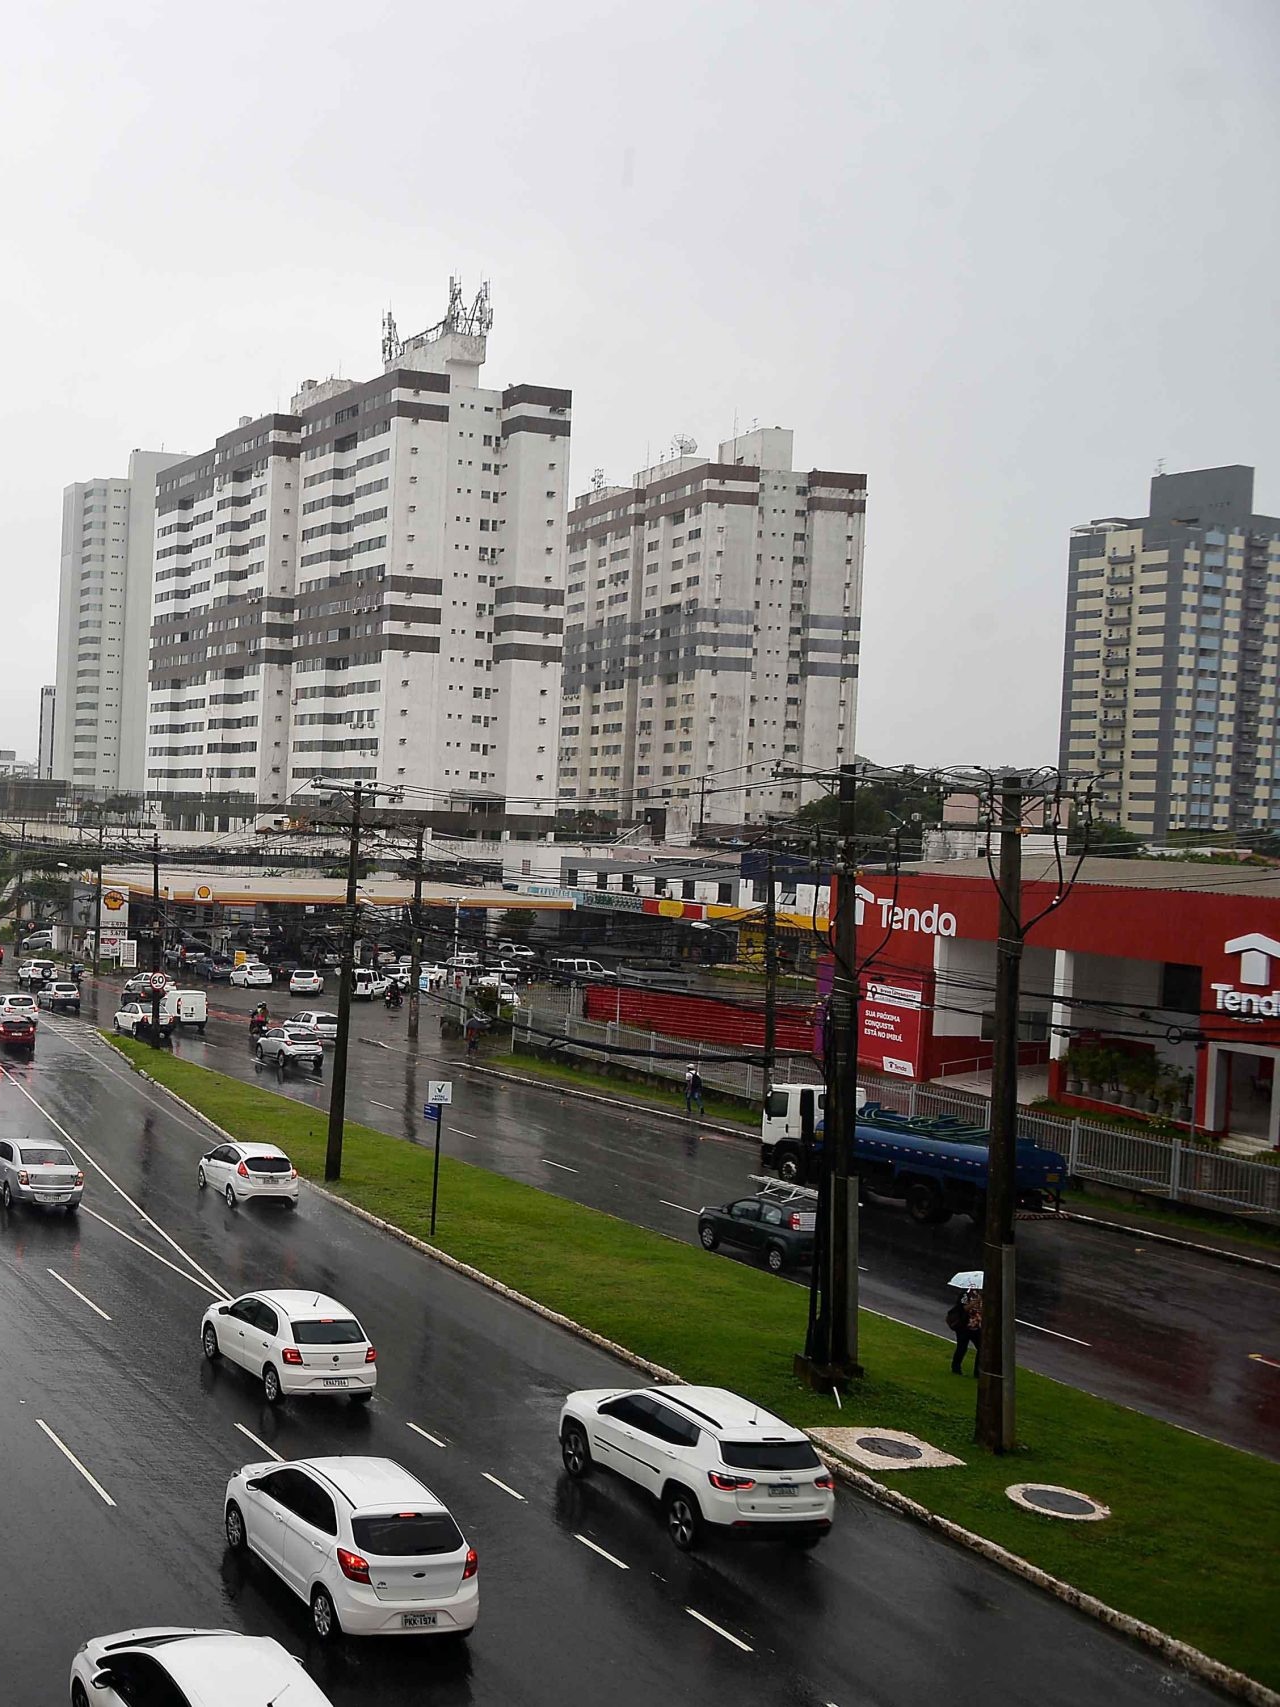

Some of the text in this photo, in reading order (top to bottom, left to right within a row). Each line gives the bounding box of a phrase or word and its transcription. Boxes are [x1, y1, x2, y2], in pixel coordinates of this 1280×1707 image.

[877, 898, 957, 936] Tenda
[152, 976, 164, 984] 60
[865, 1009, 900, 1022] SUA PRÓXIMA
[864, 1019, 894, 1031] CONQUISTA
[864, 1028, 877, 1037] ESTÁ
[877, 1031, 886, 1039] NO
